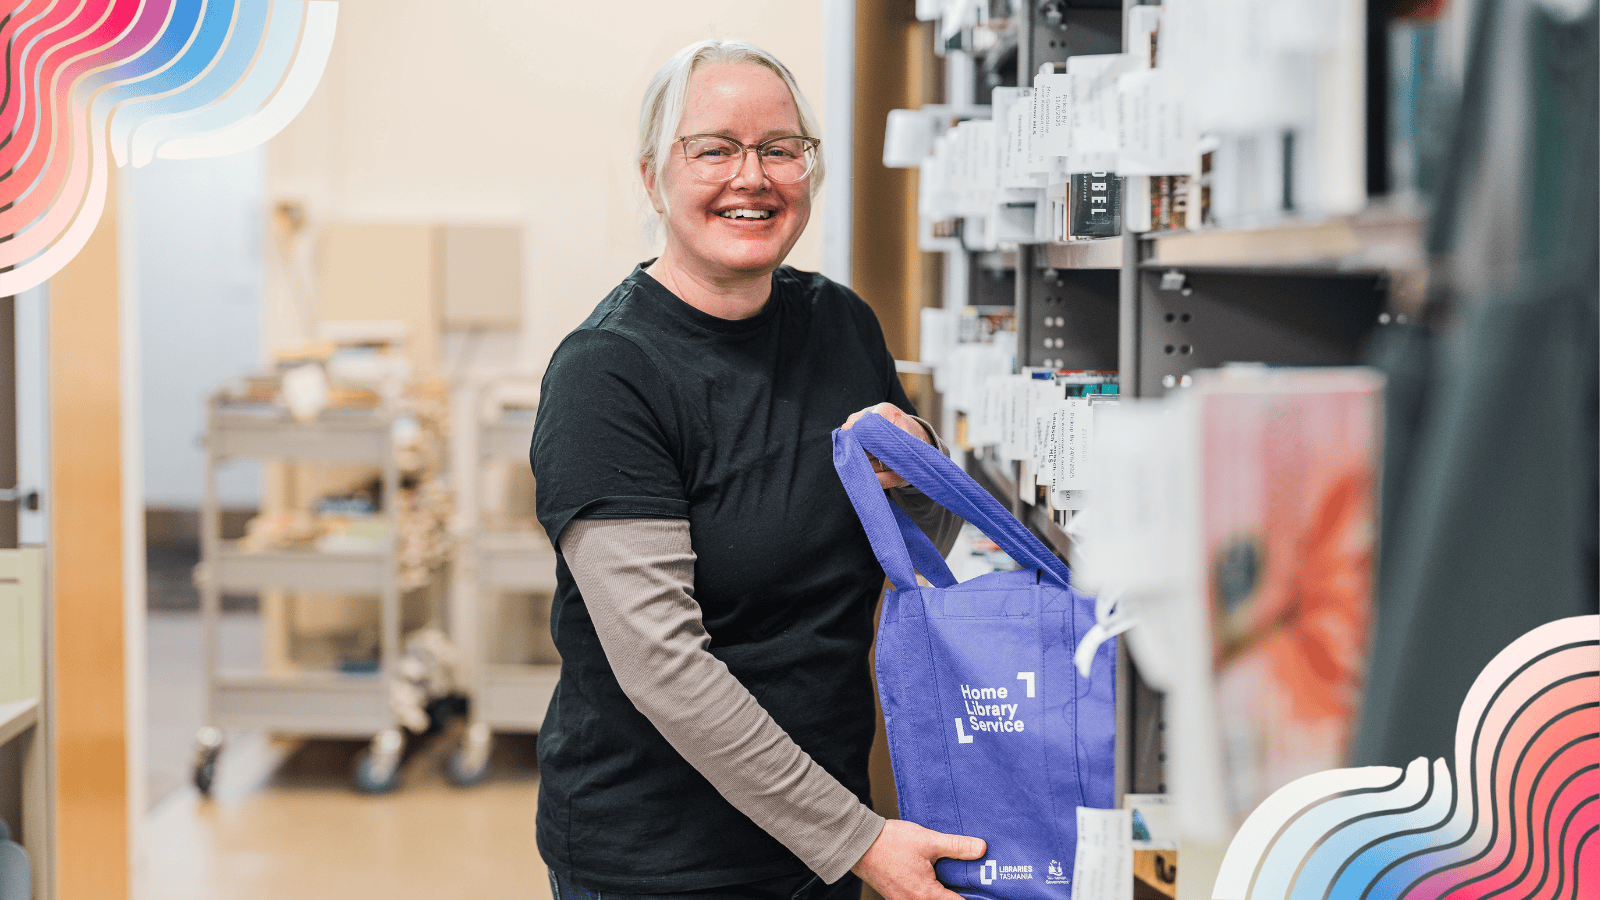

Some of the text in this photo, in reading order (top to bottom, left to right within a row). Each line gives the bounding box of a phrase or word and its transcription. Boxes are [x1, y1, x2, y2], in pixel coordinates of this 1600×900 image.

[960, 684, 1008, 700] Home
[964, 700, 1018, 720] Library
[969, 715, 1024, 732] Service
